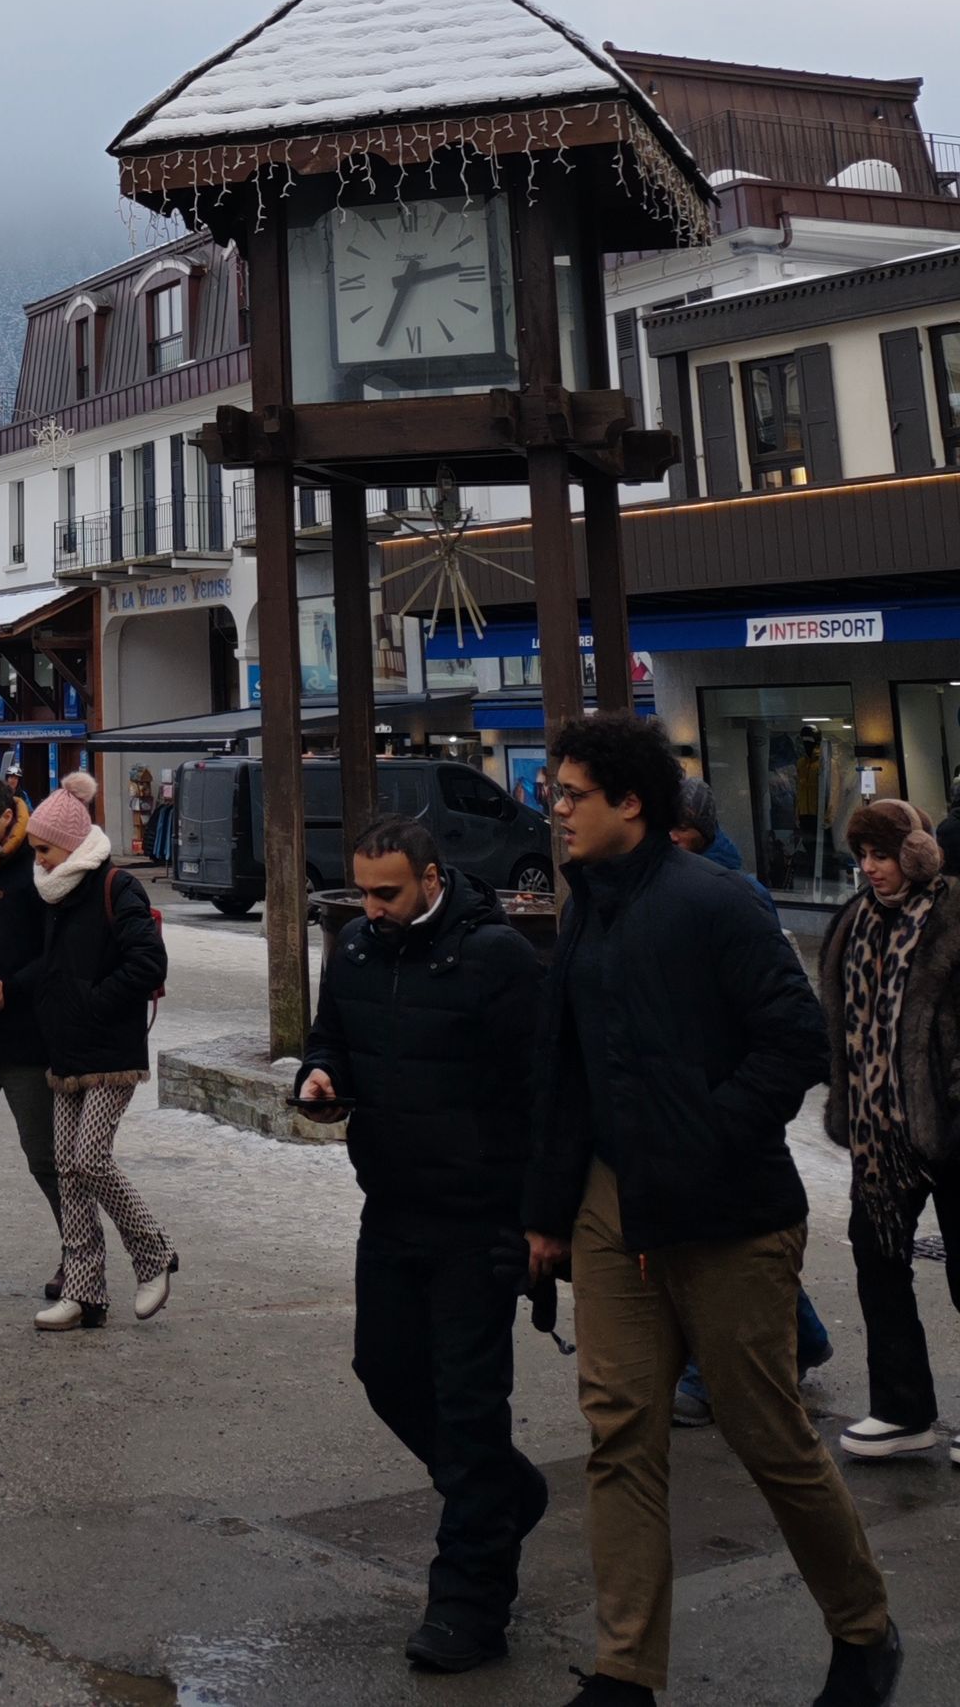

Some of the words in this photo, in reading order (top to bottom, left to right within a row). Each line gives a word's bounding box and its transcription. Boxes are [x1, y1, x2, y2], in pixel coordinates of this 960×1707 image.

[108, 587, 118, 613] A
[121, 591, 134, 609] LA
[769, 618, 875, 640] INTERSPORT
